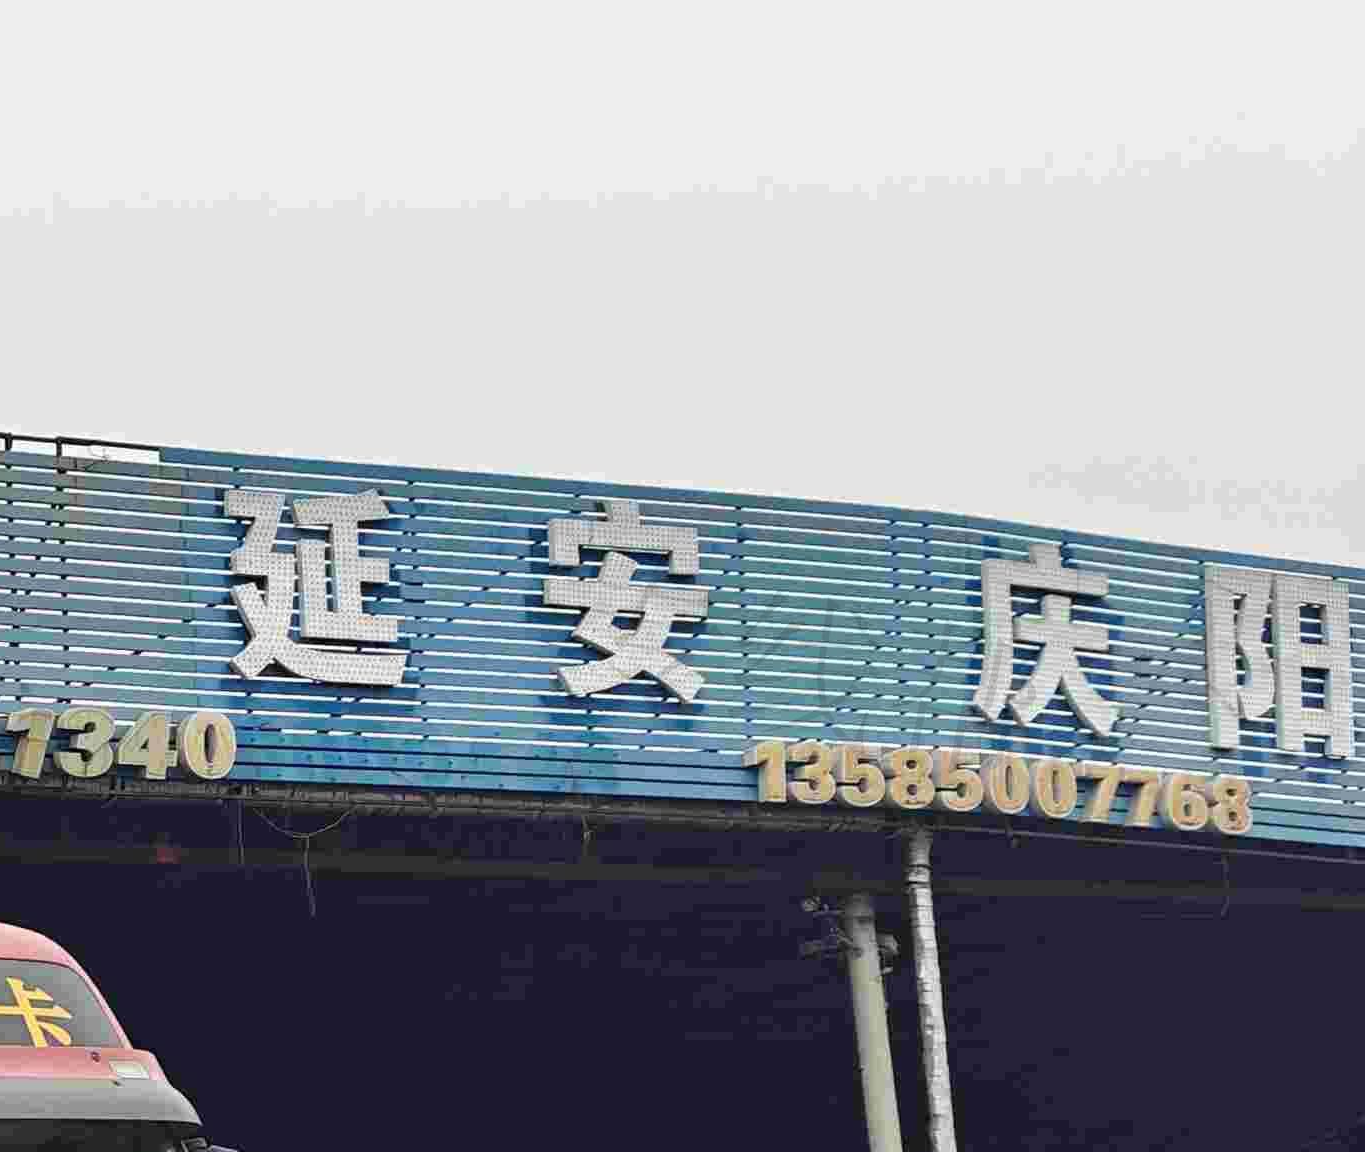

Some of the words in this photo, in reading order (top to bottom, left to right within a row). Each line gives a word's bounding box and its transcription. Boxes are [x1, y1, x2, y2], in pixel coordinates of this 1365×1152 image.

[224, 488, 708, 703] 延安
[974, 544, 1350, 758] 庆阳
[745, 742, 1253, 834] 13585007768
